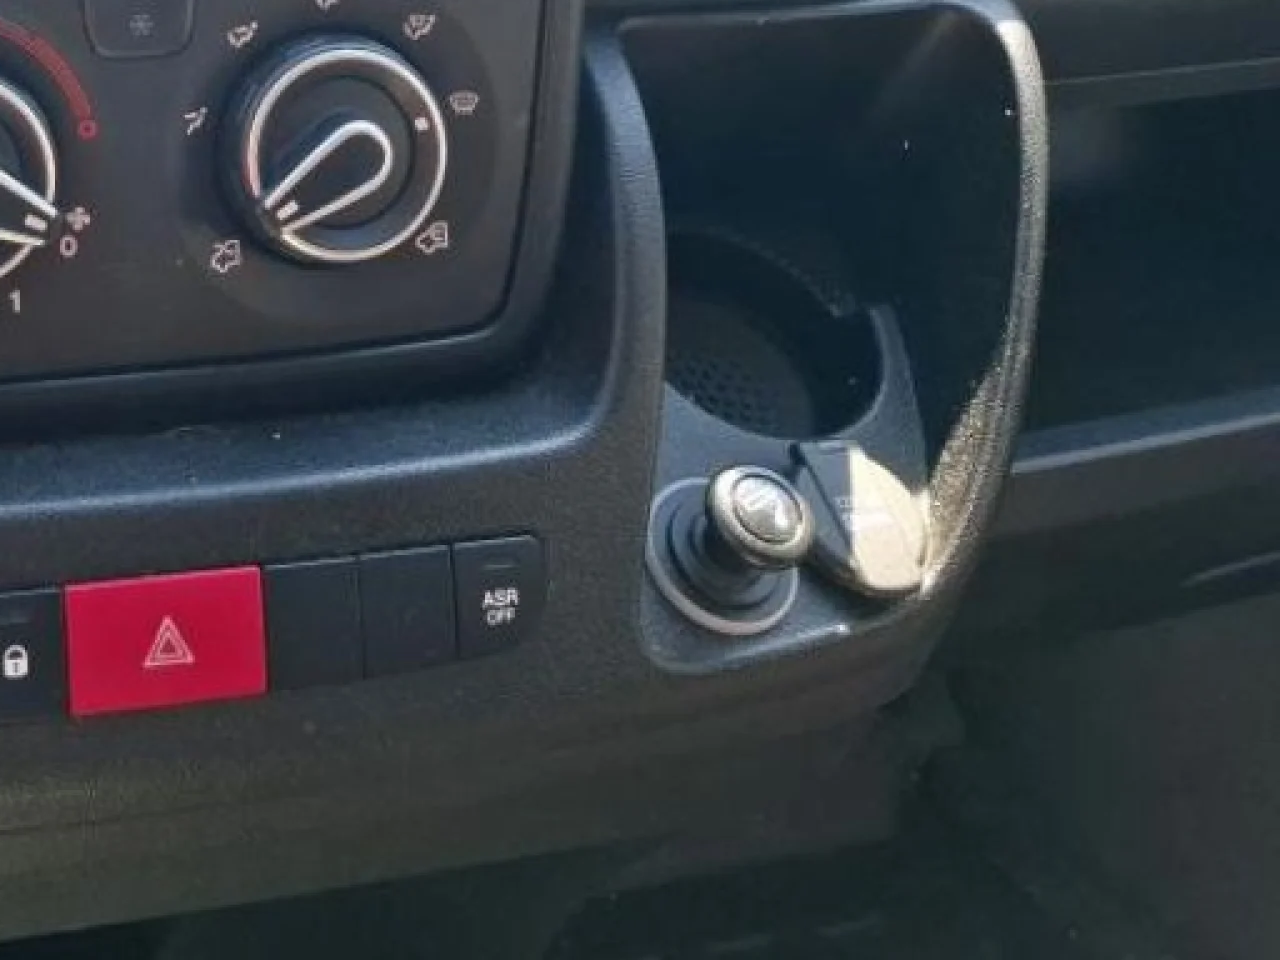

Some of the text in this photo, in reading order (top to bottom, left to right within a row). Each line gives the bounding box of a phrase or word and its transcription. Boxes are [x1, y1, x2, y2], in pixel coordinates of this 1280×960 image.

[59, 235, 78, 258] 0
[9, 290, 21, 314] 1
[483, 587, 519, 608] ASR
[486, 607, 516, 626] OFF
